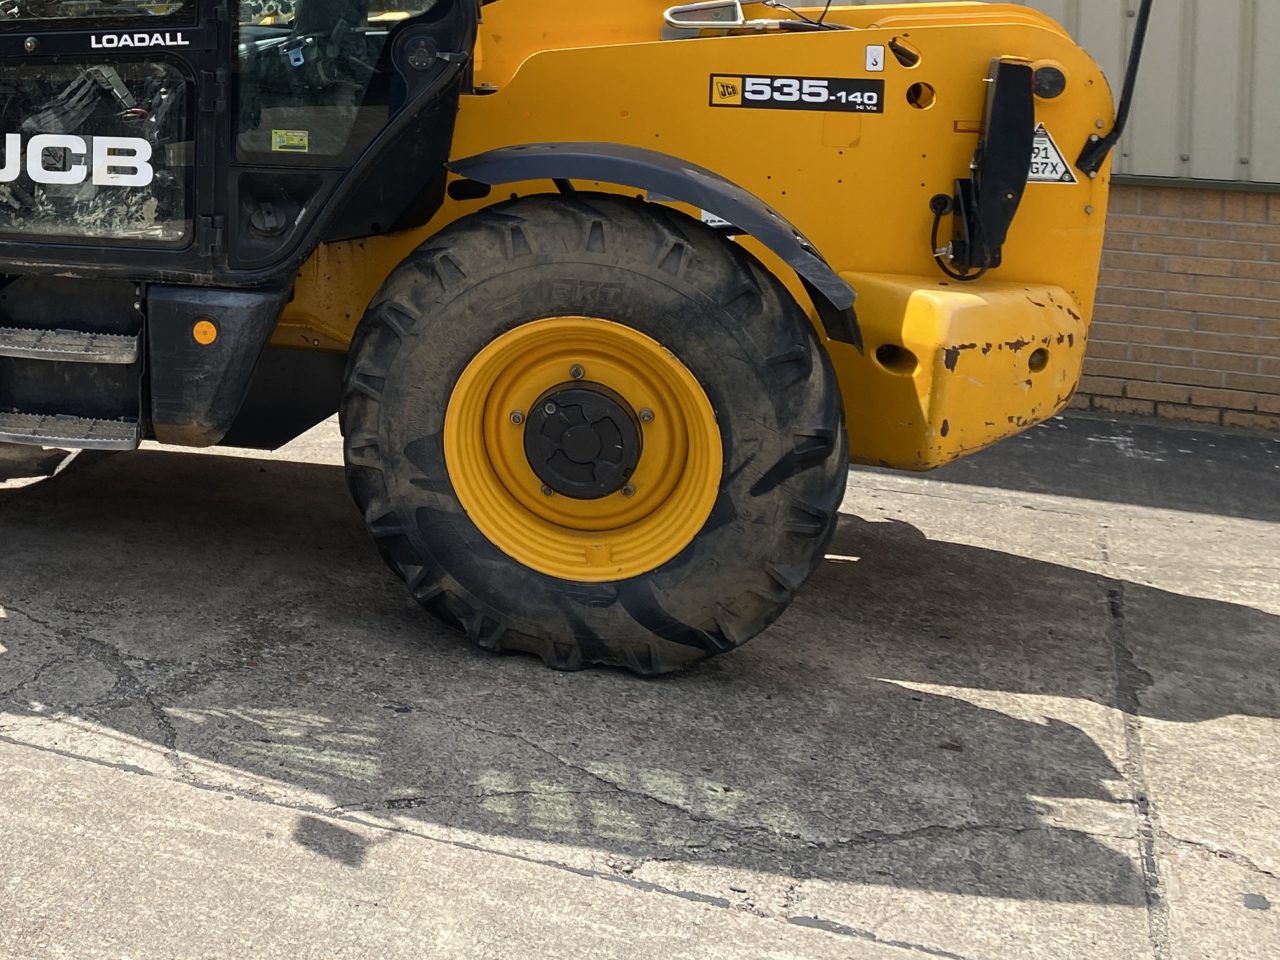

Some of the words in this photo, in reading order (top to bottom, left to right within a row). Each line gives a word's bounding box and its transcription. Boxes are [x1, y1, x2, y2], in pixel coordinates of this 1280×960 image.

[91, 32, 189, 48] LOADALL
[719, 84, 737, 97] JCB
[744, 77, 878, 104] 535-140
